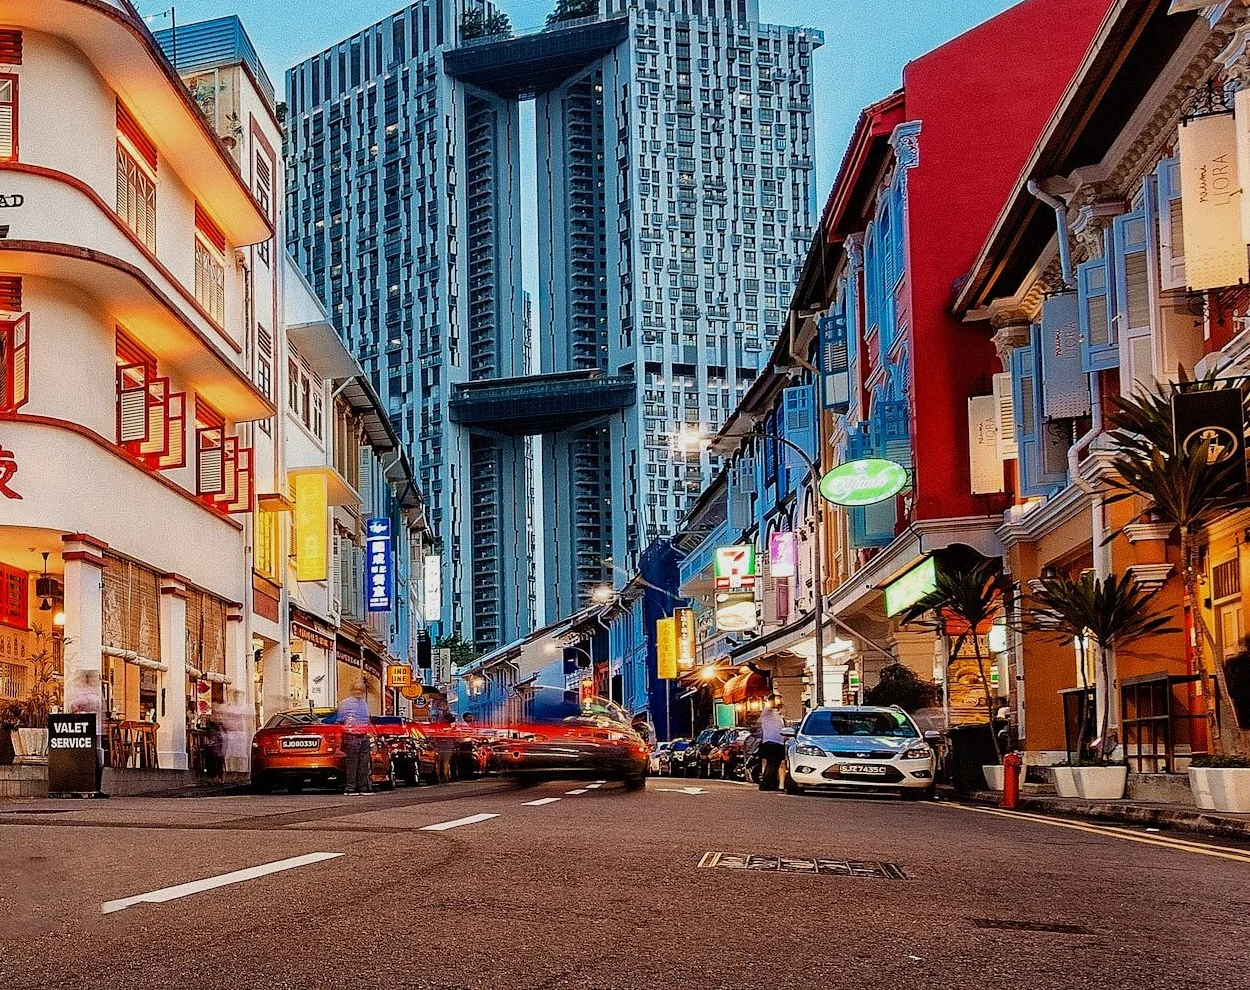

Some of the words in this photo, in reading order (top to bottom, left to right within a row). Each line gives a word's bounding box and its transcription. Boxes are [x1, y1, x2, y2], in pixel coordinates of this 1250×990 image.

[1194, 164, 1209, 203] naumi
[1212, 153, 1230, 206] LIORA
[53, 721, 89, 733] VALET
[50, 737, 91, 749] SERVICE
[841, 765, 886, 773] SJZ7435C
